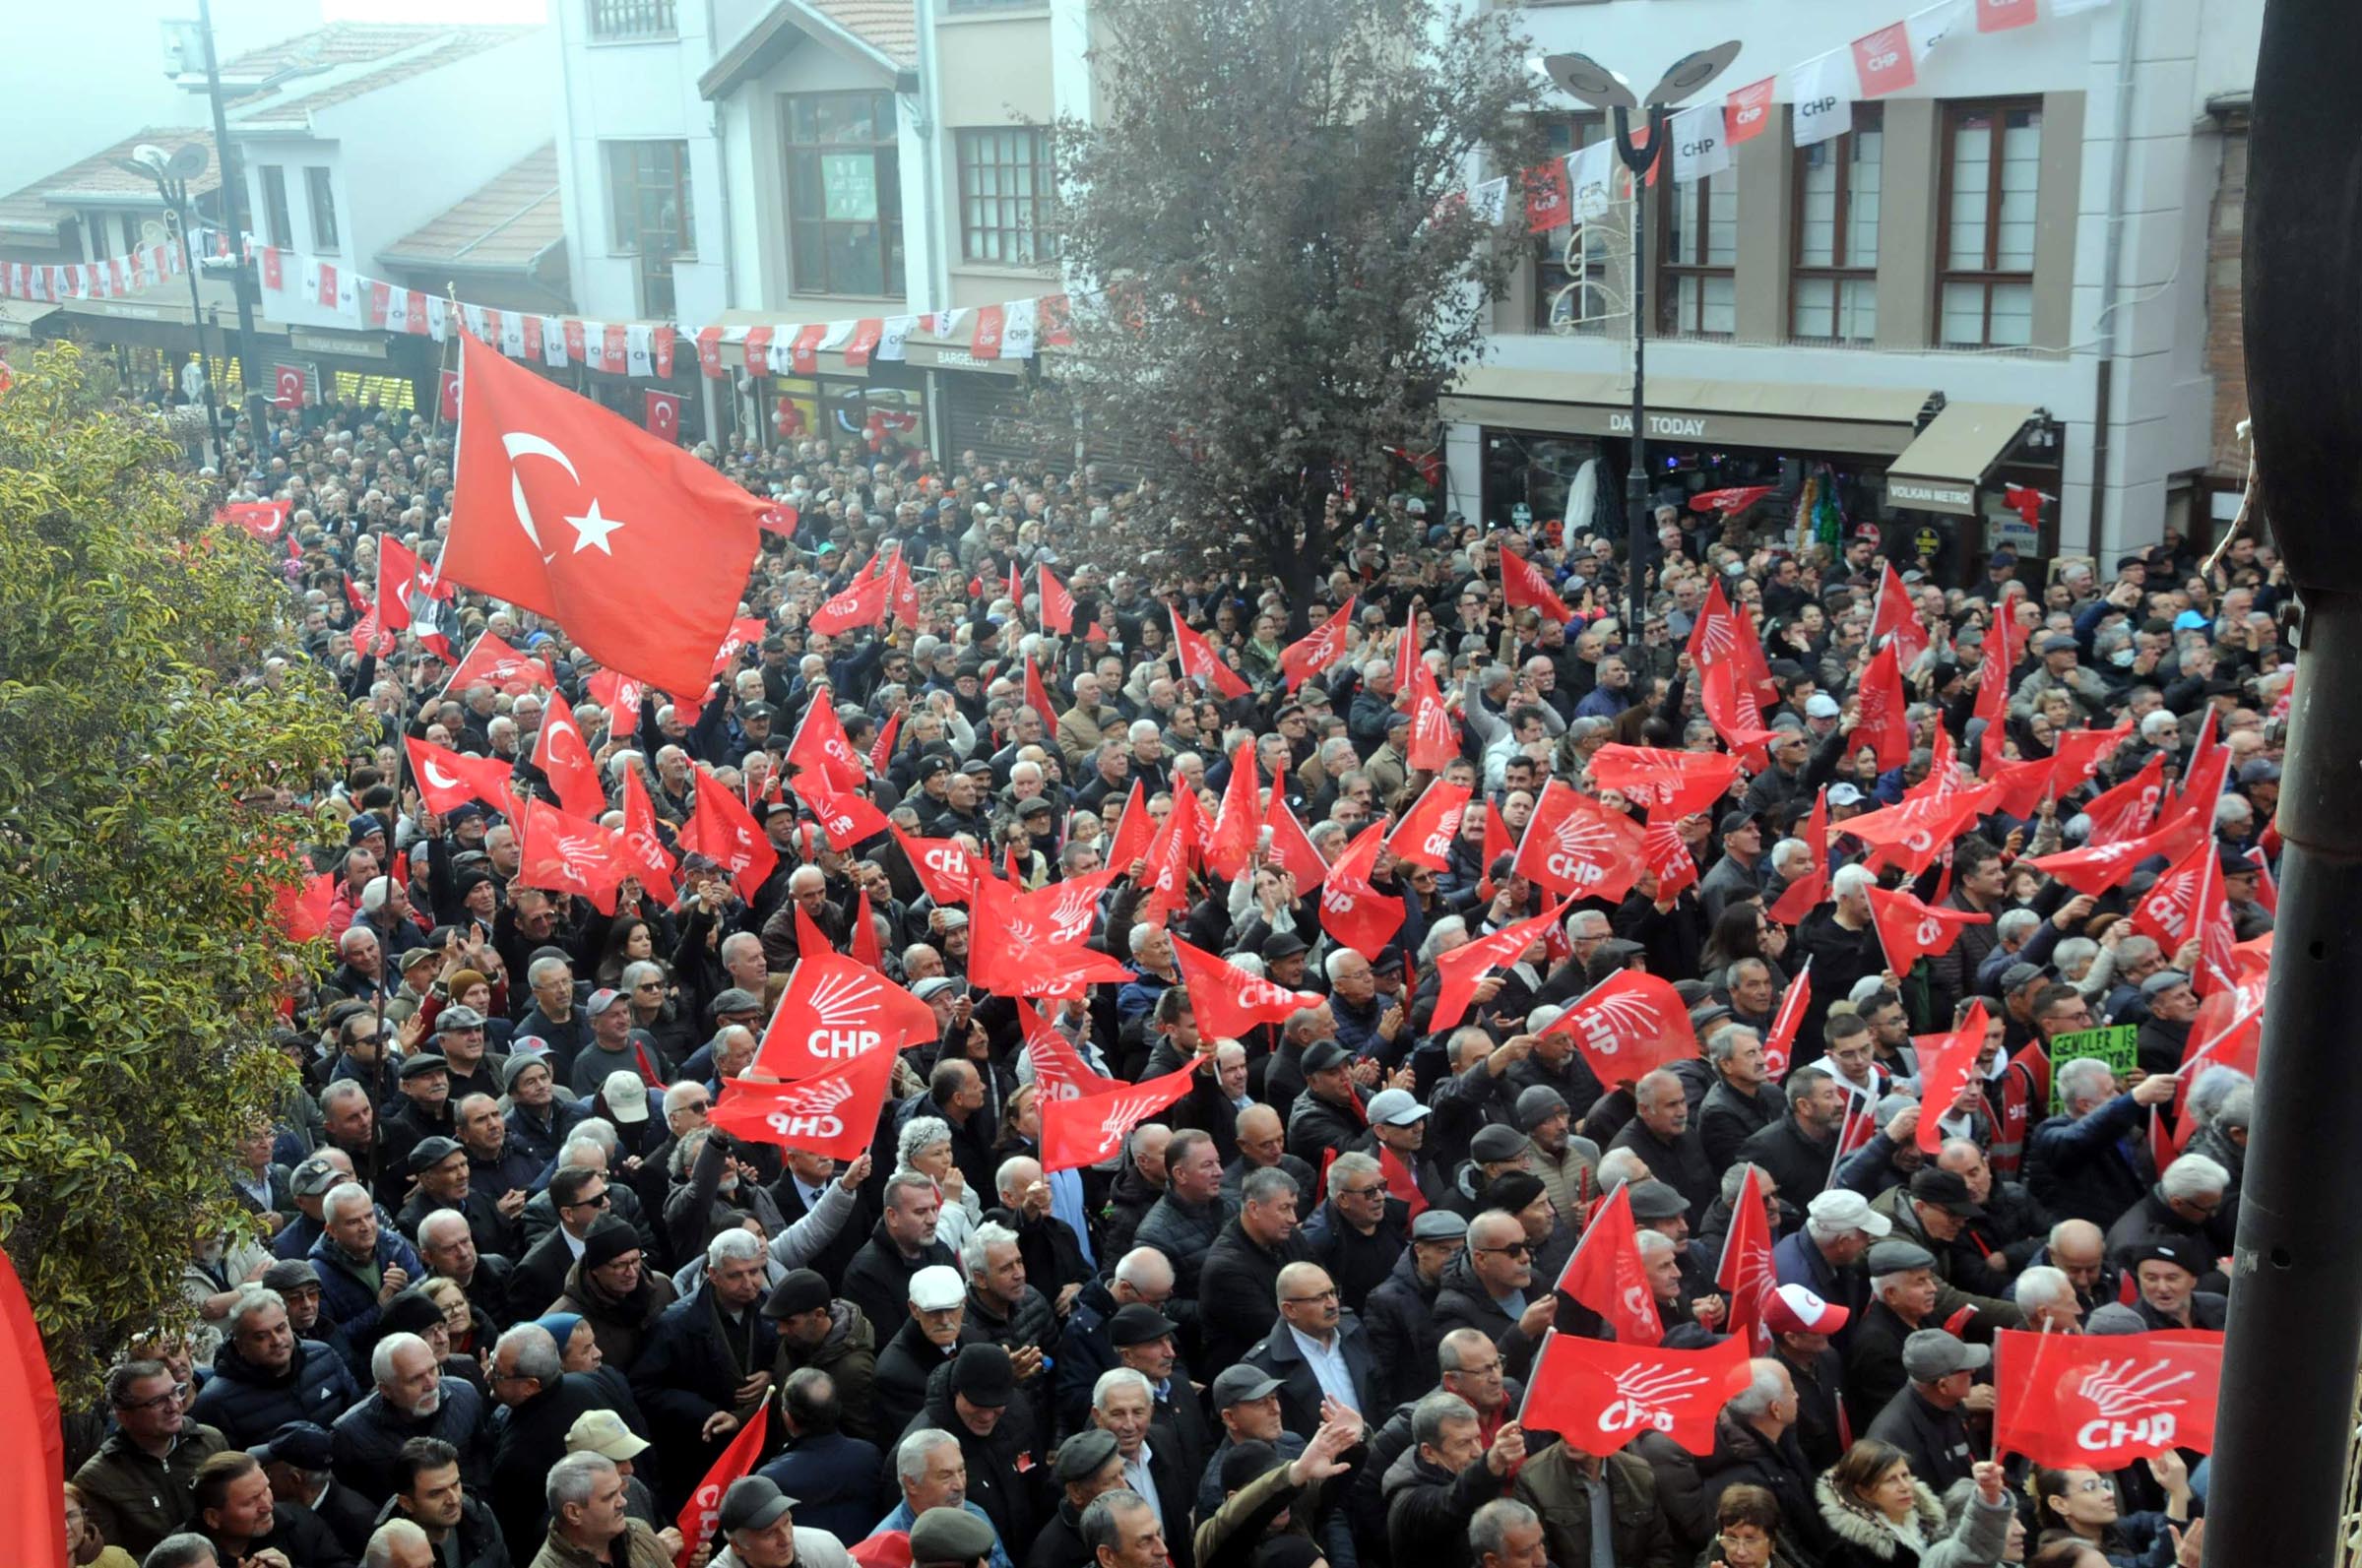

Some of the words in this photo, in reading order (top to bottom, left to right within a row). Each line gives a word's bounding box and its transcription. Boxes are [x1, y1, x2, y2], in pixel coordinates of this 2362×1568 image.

[1867, 52, 1899, 72] CHP
[1736, 107, 1762, 125] CHP
[1802, 96, 1836, 117] CHP
[1682, 138, 1715, 157] CHP
[1009, 329, 1030, 342] CHP
[1610, 414, 1633, 431] DA
[1649, 416, 1705, 436] TODAY
[1890, 485, 1932, 502] VOLKAN
[1934, 489, 1970, 505] METRO
[1424, 833, 1451, 857] CHP
[1547, 852, 1604, 886] CHP
[807, 1030, 882, 1060] CHP
[2076, 1411, 2175, 1452] CHP
